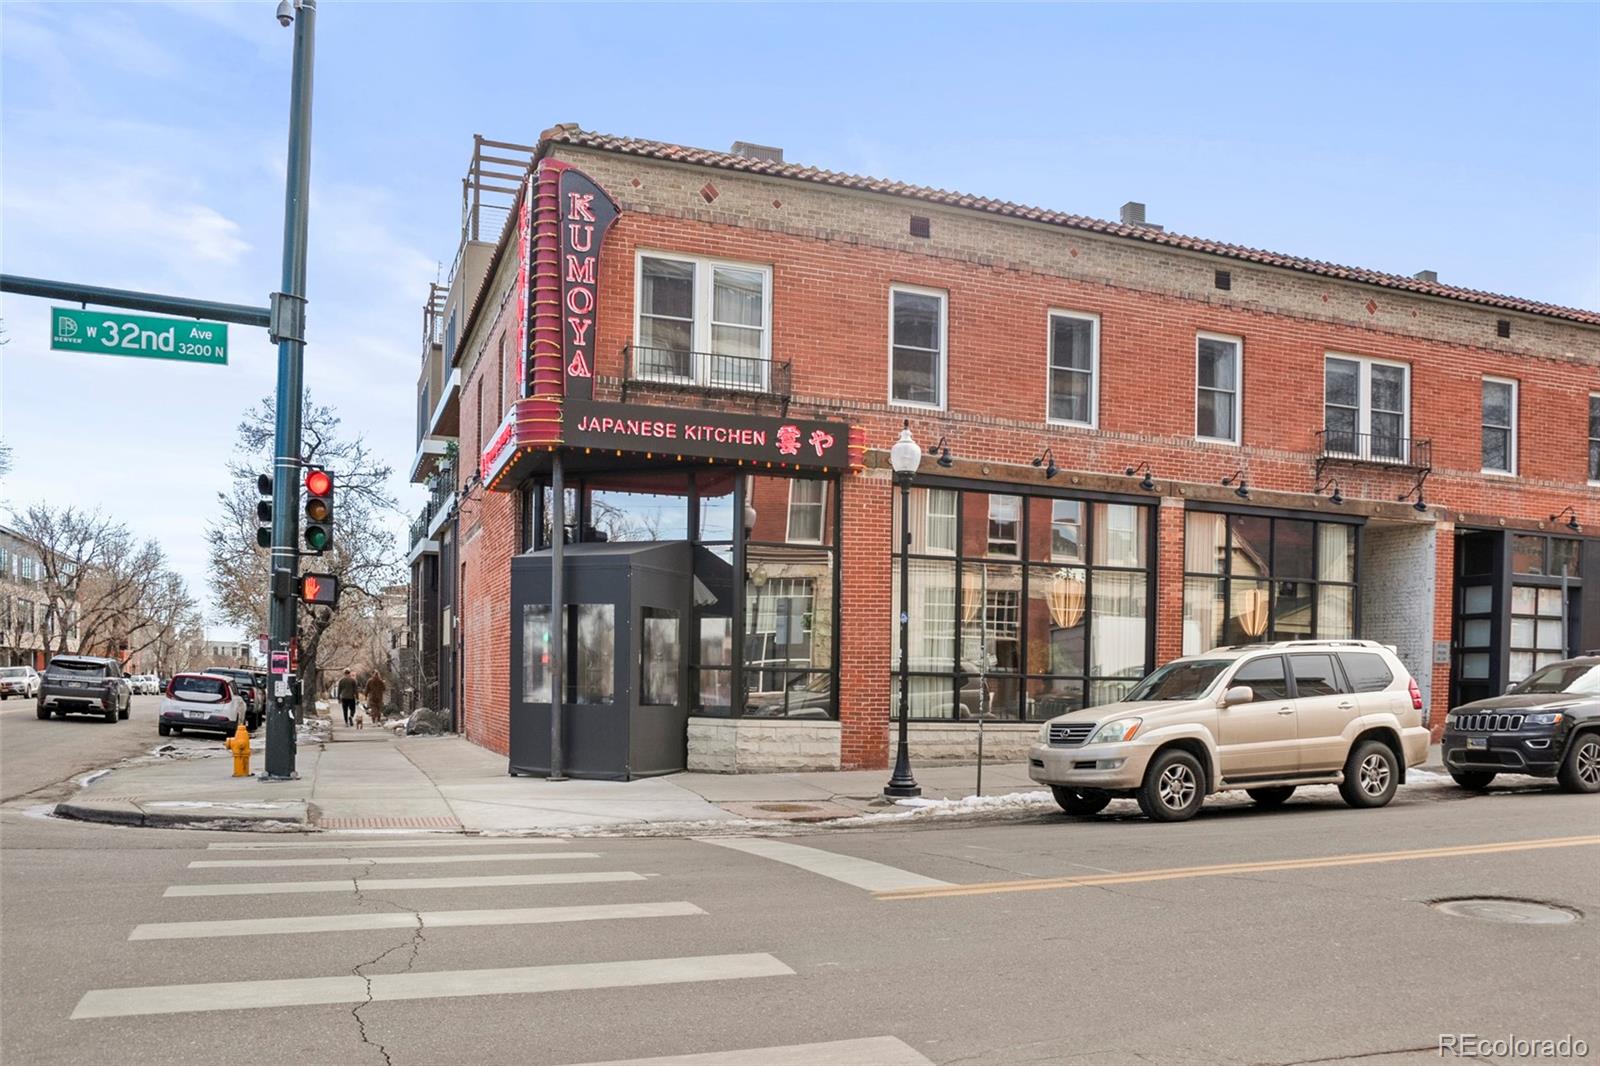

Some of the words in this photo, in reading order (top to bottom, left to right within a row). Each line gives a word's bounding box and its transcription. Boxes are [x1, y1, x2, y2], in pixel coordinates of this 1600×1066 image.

[567, 192, 597, 378] KUMOYA
[54, 336, 83, 344] DENVER
[86, 326, 98, 338] W
[101, 321, 175, 351] 32nd
[189, 327, 213, 341] Ave
[178, 343, 212, 357] 3200
[215, 346, 224, 358] N
[577, 416, 678, 439] JAPANESE
[684, 424, 766, 446] KITCHEN
